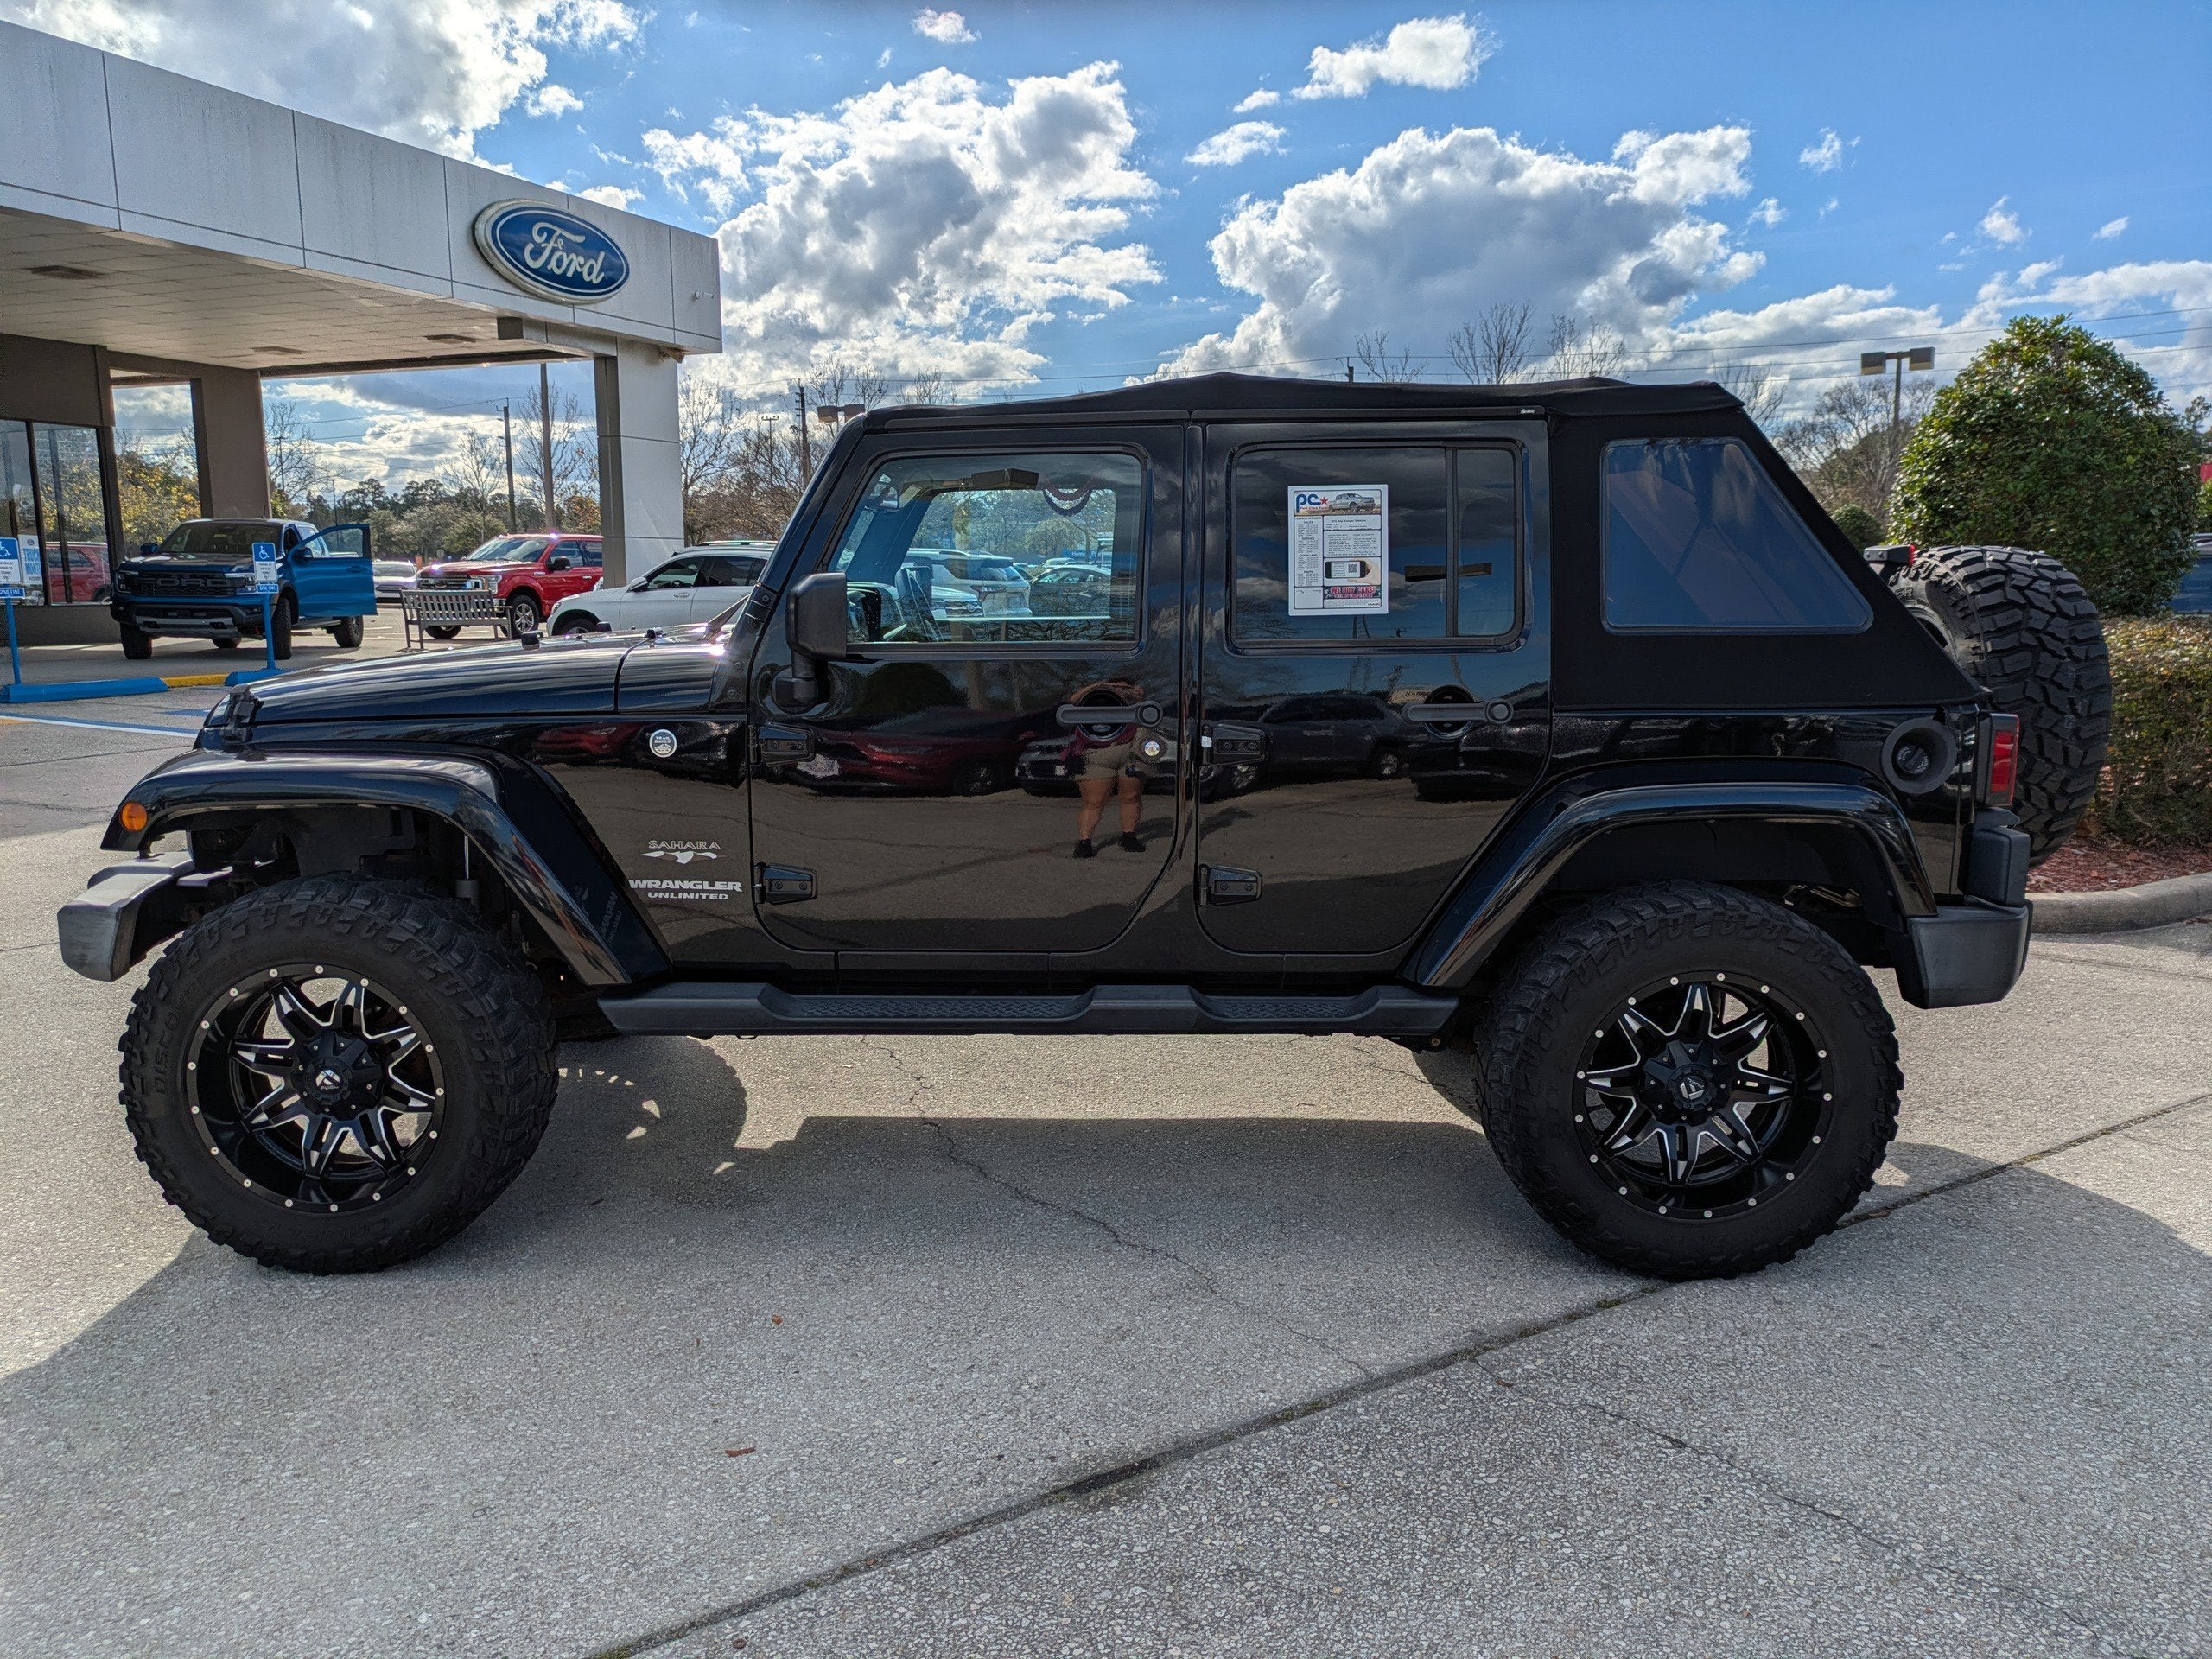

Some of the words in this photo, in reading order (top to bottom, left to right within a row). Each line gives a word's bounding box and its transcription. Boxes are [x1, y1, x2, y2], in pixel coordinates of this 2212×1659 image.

[524, 222, 607, 285] Ford
[648, 840, 721, 850] SAHARA
[628, 880, 742, 893] WRANGLER
[647, 892, 729, 900] UNLIMITED
